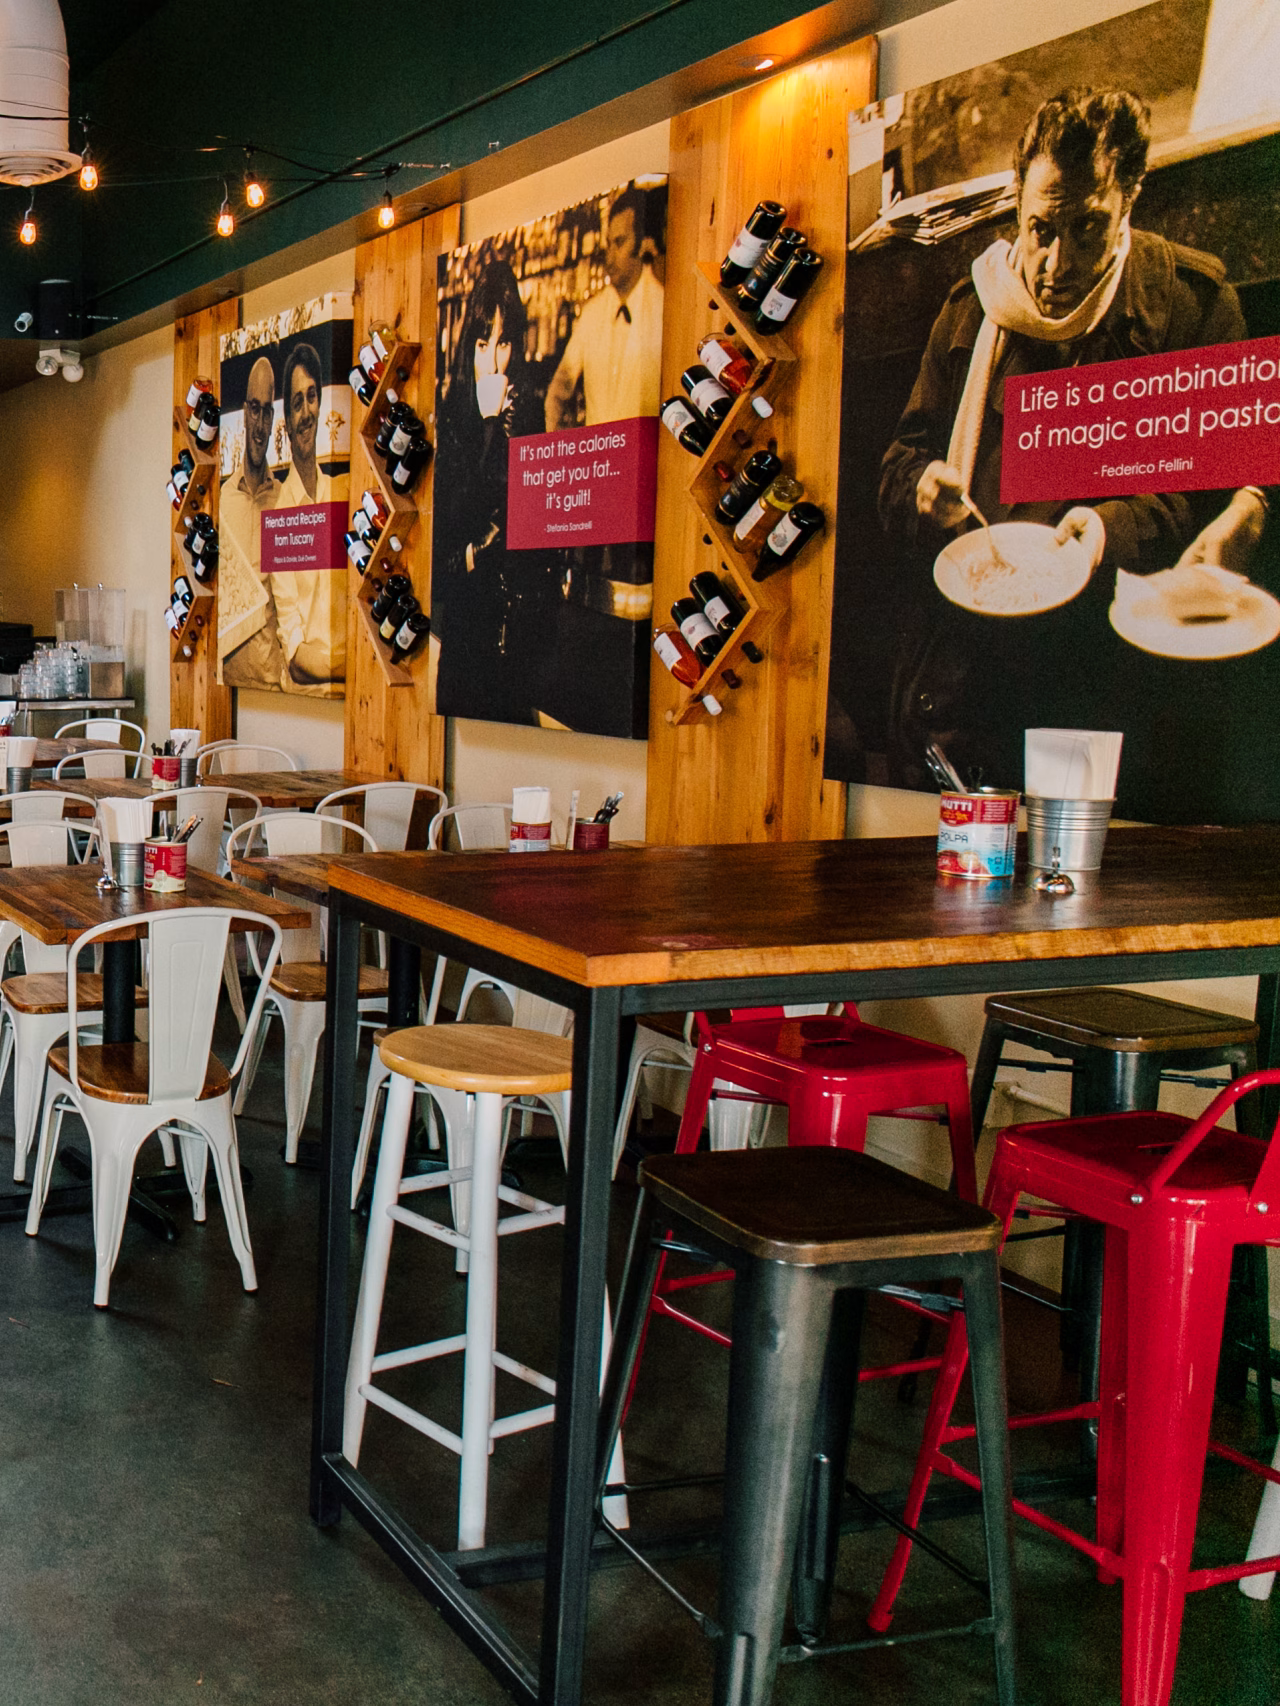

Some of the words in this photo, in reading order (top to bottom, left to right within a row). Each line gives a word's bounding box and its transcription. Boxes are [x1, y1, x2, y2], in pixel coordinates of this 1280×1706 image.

[1019, 384, 1059, 413] Life
[1065, 382, 1081, 407] is
[1087, 383, 1105, 403] a
[1113, 355, 1280, 401] combinatio
[1018, 422, 1042, 450] of
[1048, 415, 1127, 449] magic
[1135, 407, 1191, 438] and
[520, 445, 535, 462] It's
[536, 442, 555, 459] not
[557, 440, 576, 457] the
[578, 432, 626, 454] calories
[523, 469, 545, 486] that
[546, 466, 565, 488] get
[568, 467, 590, 486] you
[592, 460, 620, 478] fat...
[1100, 461, 1156, 478] Federico
[1158, 457, 1194, 473] Fellini
[546, 492, 561, 510] it's
[563, 488, 591, 512] guilt!
[265, 514, 286, 529] Friends
[286, 512, 299, 527] and
[300, 511, 326, 527] Recipes
[546, 523, 569, 533] Stefania
[274, 533, 289, 547] from
[289, 532, 315, 547] Tuscany
